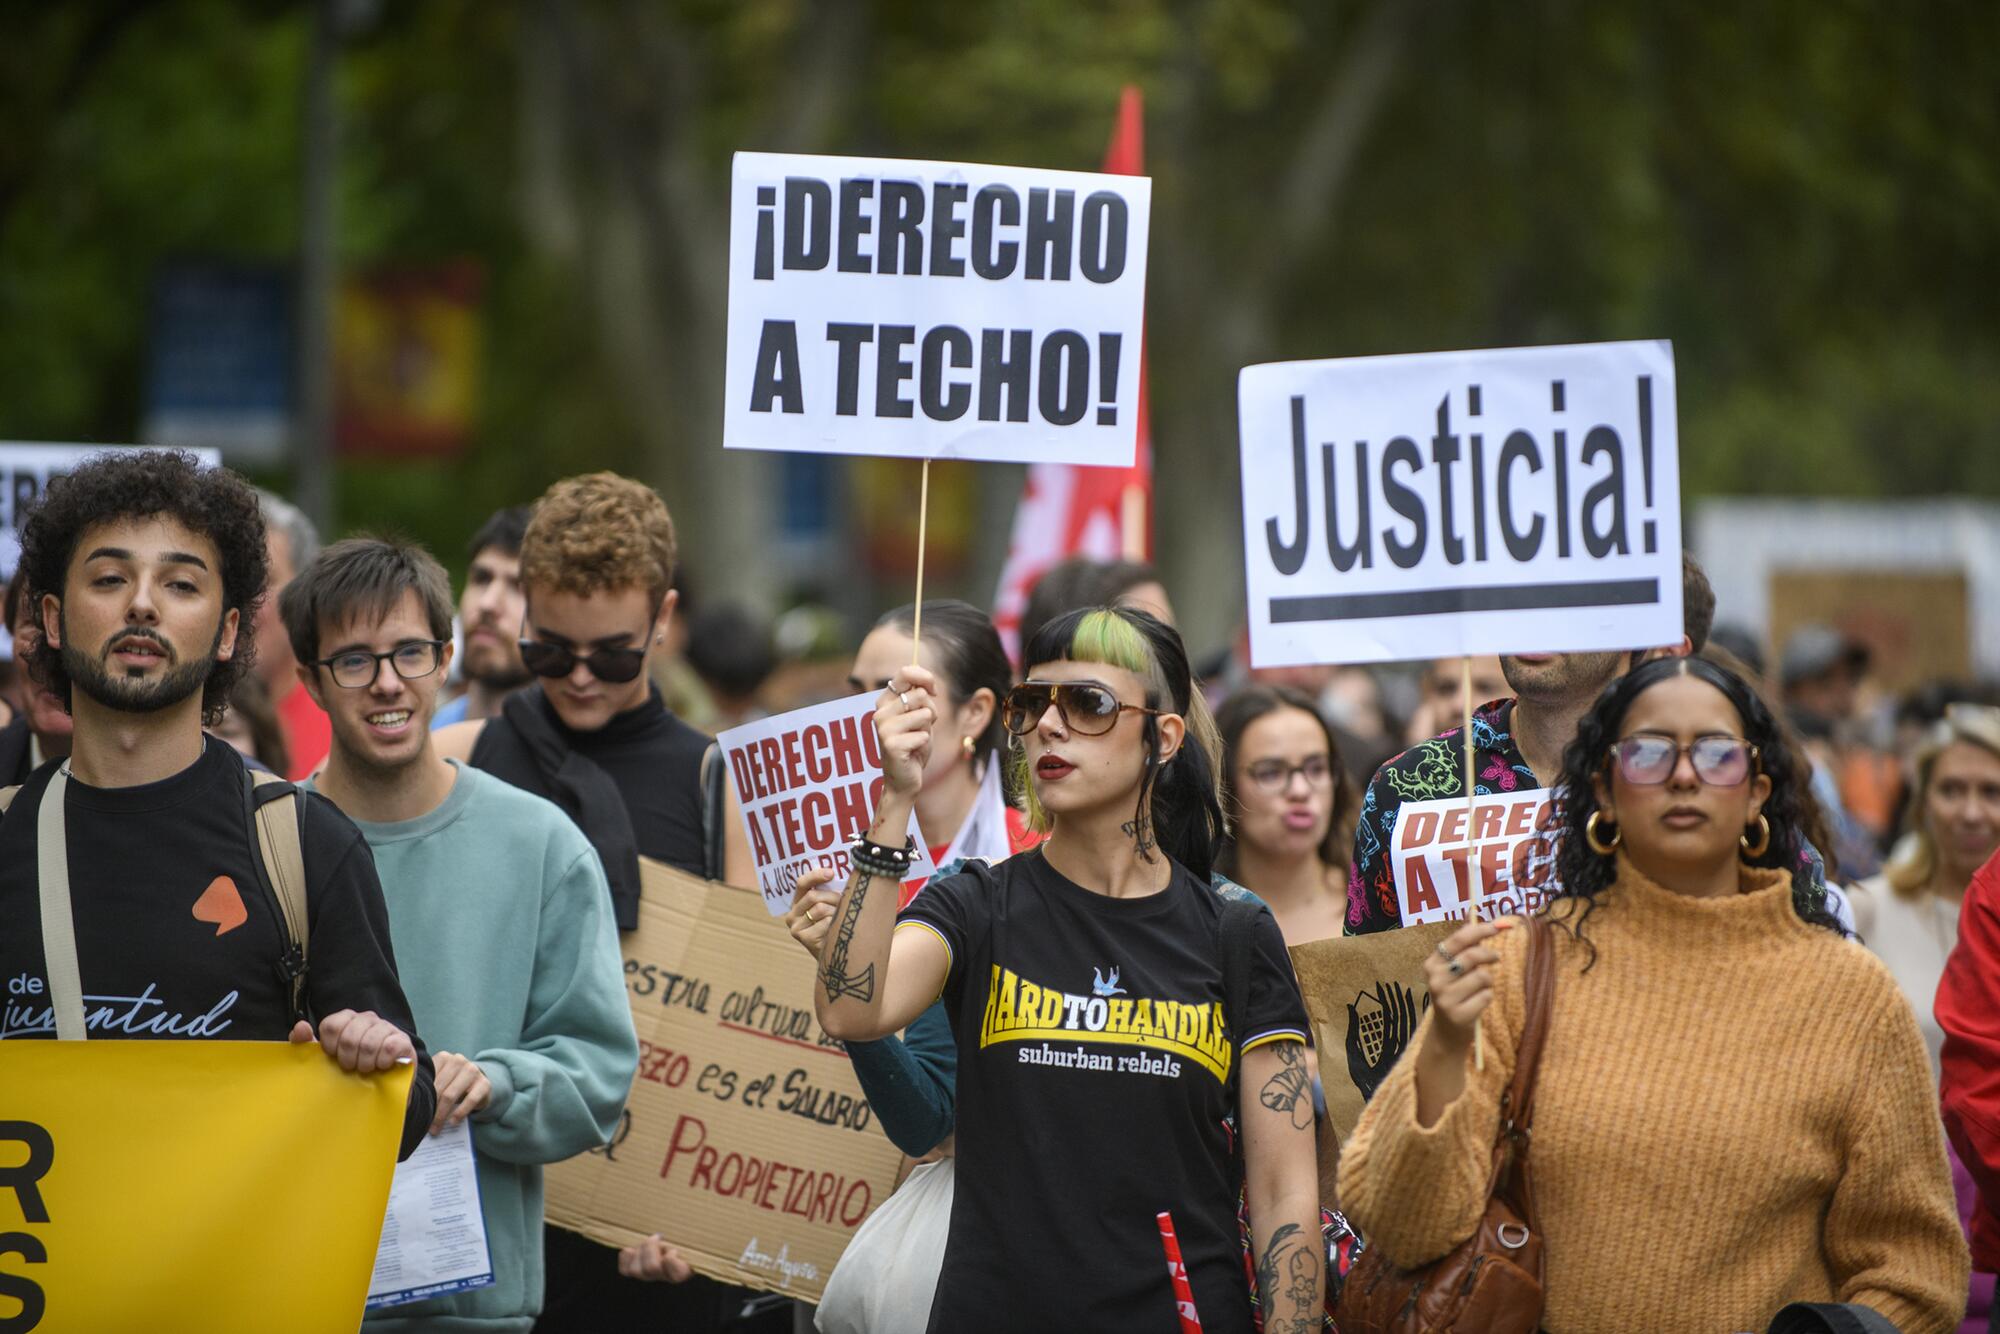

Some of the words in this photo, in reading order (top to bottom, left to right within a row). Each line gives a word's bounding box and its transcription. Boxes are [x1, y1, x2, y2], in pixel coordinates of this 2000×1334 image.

[753, 175, 1129, 284] ¡DERECHO
[749, 319, 804, 414] A
[826, 321, 1123, 426] TECHO!
[1265, 374, 1657, 576] Justicia!
[1405, 854, 1441, 915] A
[0, 983, 239, 1040] juvntud
[9, 973, 43, 994] de
[696, 1063, 739, 1101] es
[742, 1073, 777, 1109] el
[1018, 1043, 1113, 1071] suburban
[1117, 1051, 1182, 1078] rebels
[659, 1114, 872, 1227] PROPIETARIO
